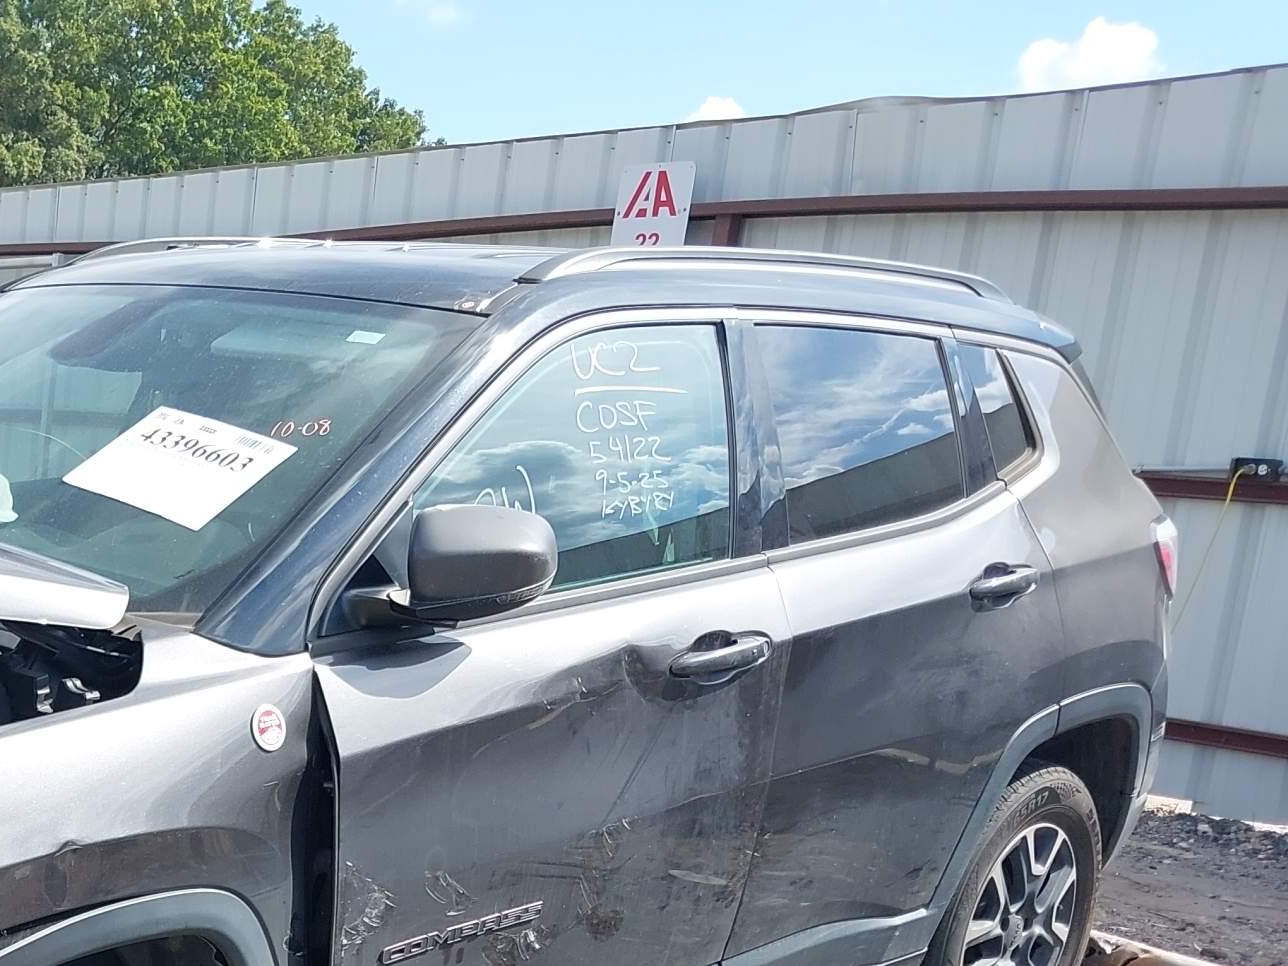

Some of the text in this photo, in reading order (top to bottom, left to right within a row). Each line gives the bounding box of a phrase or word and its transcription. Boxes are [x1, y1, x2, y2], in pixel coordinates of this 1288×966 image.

[140, 428, 255, 472] 43396603
[269, 418, 333, 438] 10-08
[381, 900, 545, 966] COMPASS
